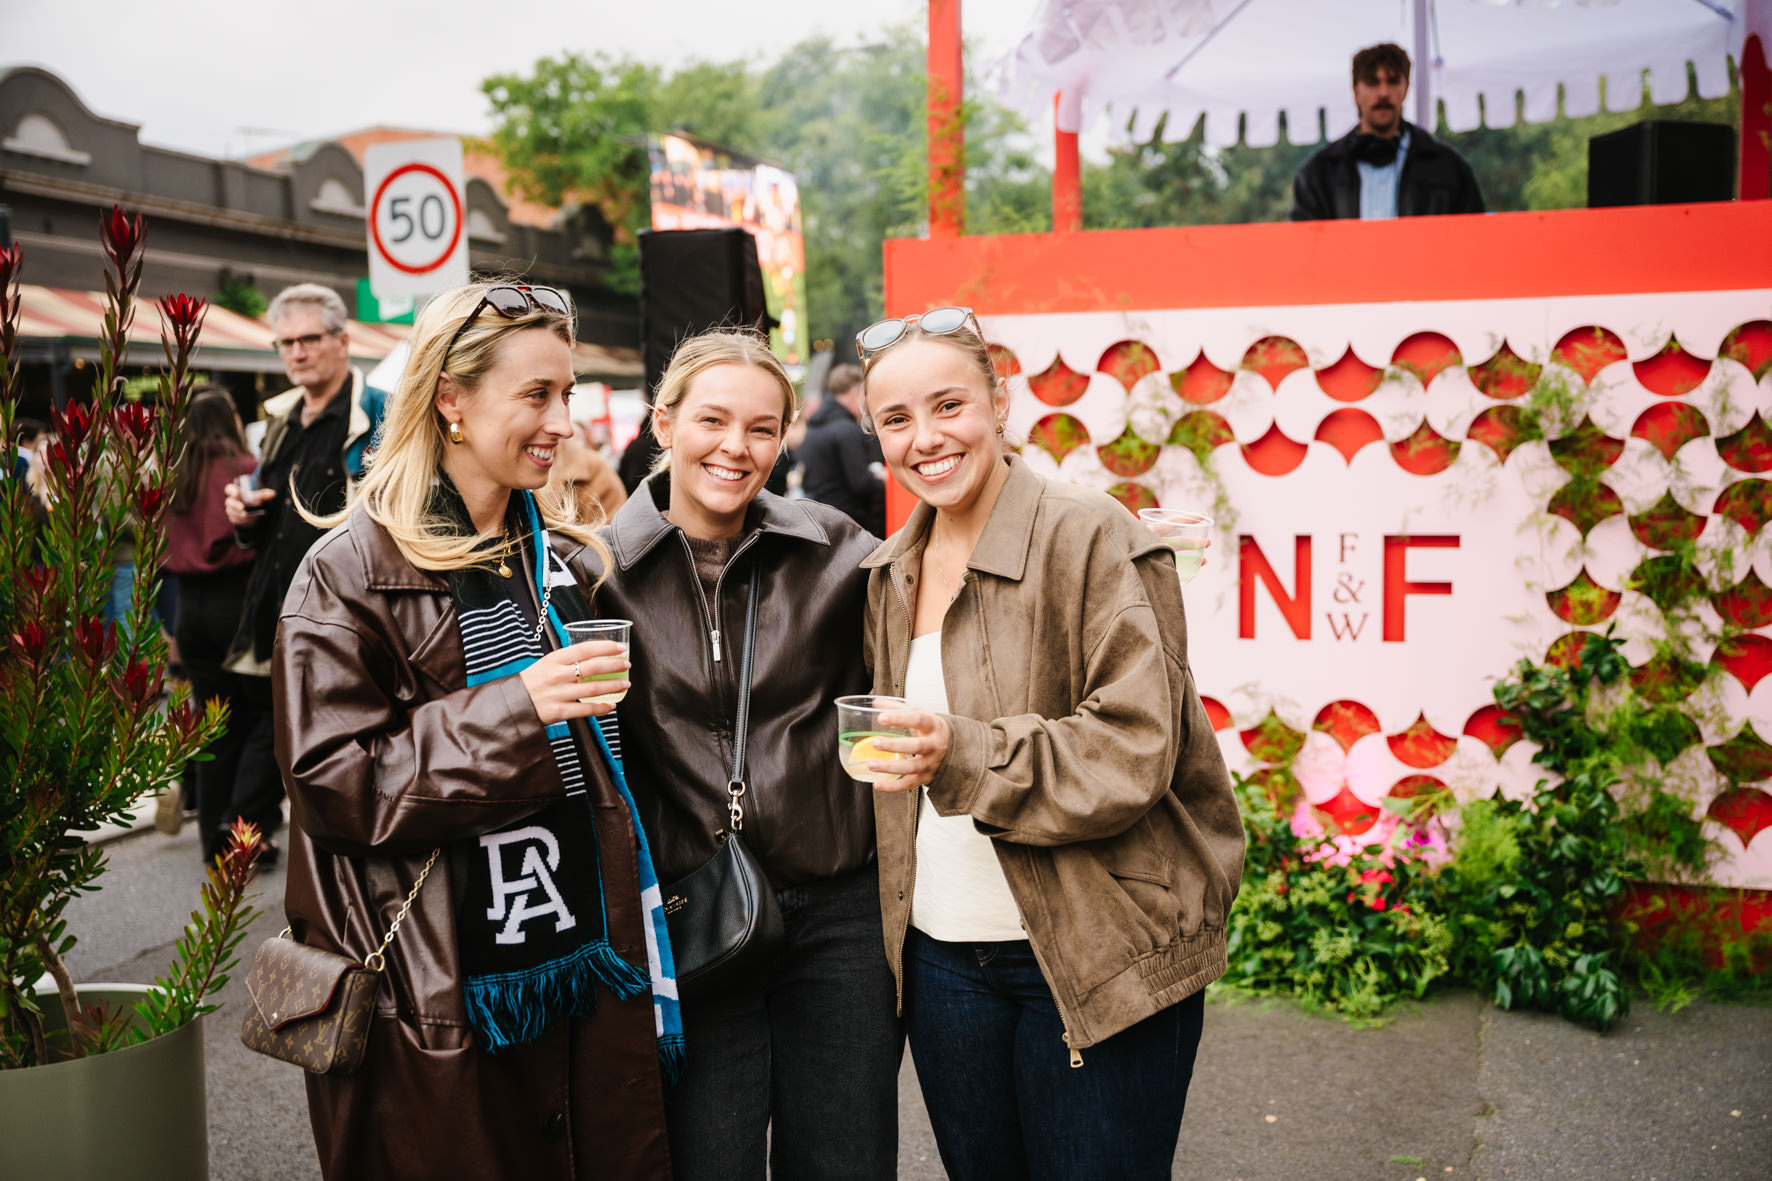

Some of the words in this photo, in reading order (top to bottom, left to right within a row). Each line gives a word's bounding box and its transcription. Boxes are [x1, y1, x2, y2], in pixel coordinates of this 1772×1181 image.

[390, 195, 446, 243] 50
[1339, 533, 1359, 563] F
[1238, 533, 1312, 641] N
[1382, 533, 1461, 643] F
[1333, 571, 1366, 605] &
[1326, 612, 1369, 642] W
[479, 825, 577, 945] PA
